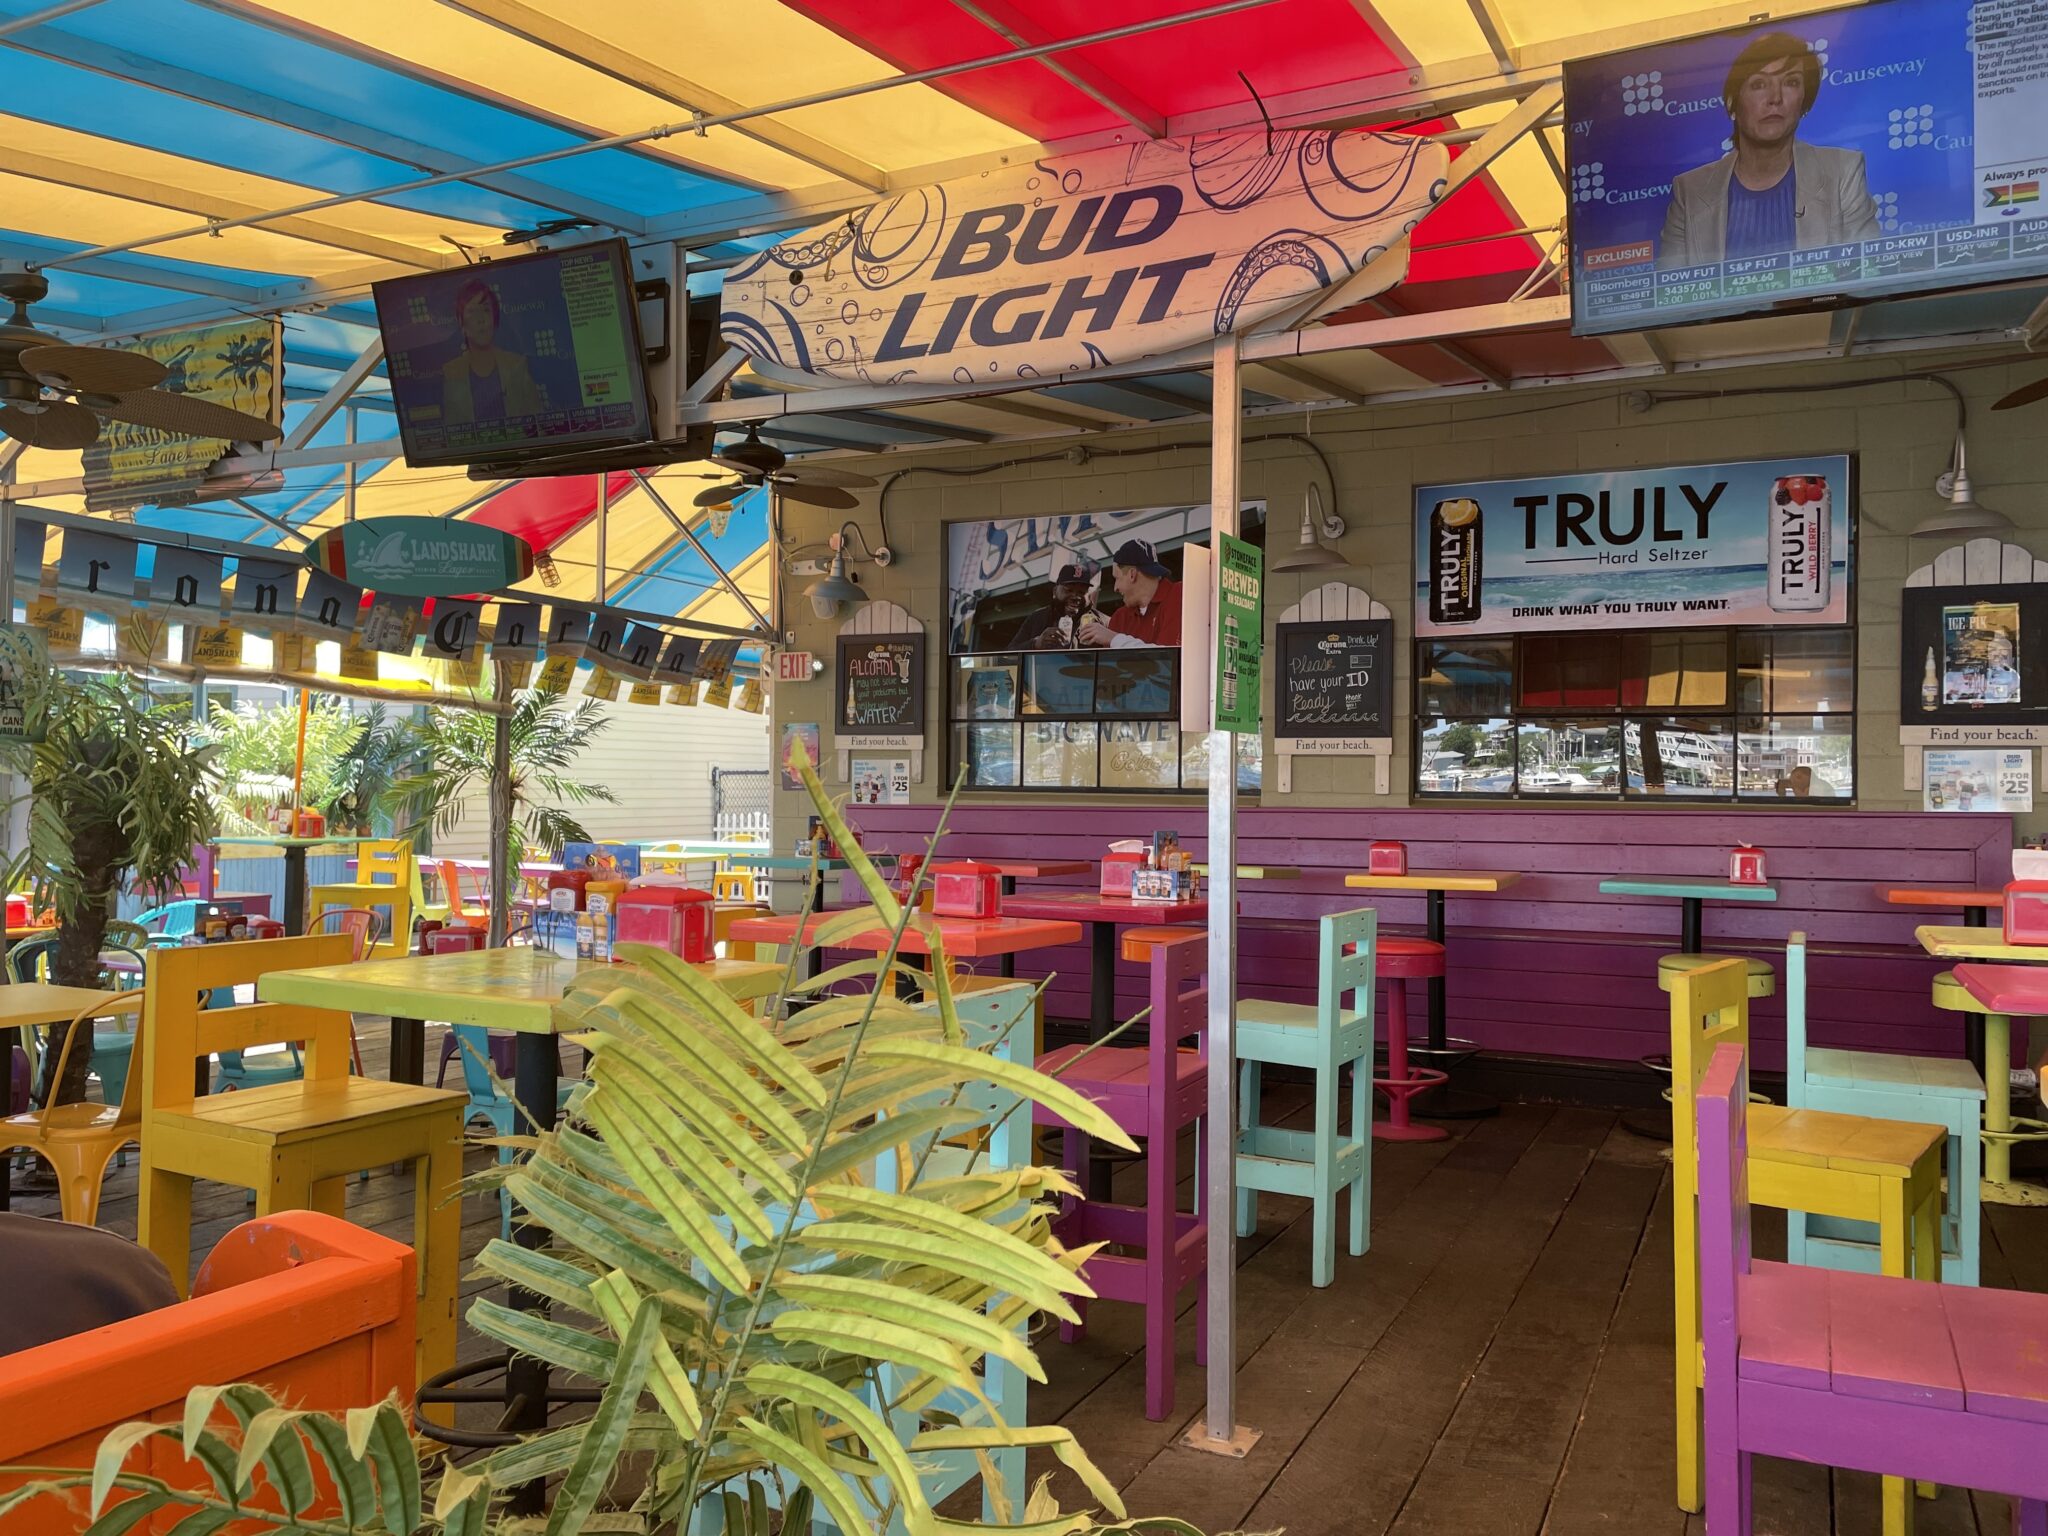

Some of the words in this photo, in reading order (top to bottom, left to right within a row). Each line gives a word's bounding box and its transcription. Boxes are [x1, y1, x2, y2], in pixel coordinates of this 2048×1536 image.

[1975, 13, 2001, 24] Hang
[2003, 10, 2011, 18] in
[2013, 8, 2030, 16] the
[1975, 20, 2015, 33] Shifting
[1978, 42, 1996, 51] The
[1978, 50, 2004, 61] being
[2006, 44, 2039, 55] closely
[1978, 62, 1989, 70] by
[2004, 53, 2043, 65] markets
[1829, 57, 1927, 86] Causeway
[1978, 69, 1997, 80] deal
[1999, 64, 2026, 75] would
[1978, 75, 2024, 89] sanctions
[2026, 73, 2038, 81] on
[1978, 86, 2016, 98] exports.
[1934, 135, 1973, 151] Cau
[1984, 170, 2025, 182] Always
[932, 184, 1184, 280] BUD
[1946, 226, 1999, 243] USD-INR
[1977, 240, 2000, 250] VIEW
[1587, 246, 1651, 265] EXCLUSIVE
[1807, 250, 1831, 261] FUT
[1875, 253, 1900, 263] 2-DAY
[1902, 250, 1924, 259] VIEW
[1729, 260, 1752, 273] S&P
[1755, 257, 1778, 269] FUT
[1661, 270, 1690, 283] DOW
[1693, 266, 1716, 279] FUT
[1731, 272, 1774, 286] 4236.60
[1590, 277, 1650, 293] Bloomberg
[1664, 281, 1712, 296] 34357.00
[874, 252, 1217, 363] LIGHT
[1513, 481, 1728, 549] TRULY
[1809, 521, 1817, 552] BERRY
[411, 539, 497, 562] LANDSHARK
[1231, 548, 1257, 568] STONEFACE
[1599, 549, 1638, 565] Hard
[1648, 547, 1709, 562] Seltzer
[1782, 508, 1804, 594] TRULY
[1440, 529, 1461, 610] TRULY
[1809, 554, 1817, 581] WILD
[1222, 566, 1259, 599] BREWED
[1460, 557, 1469, 598] ORIGINAL
[1234, 594, 1255, 611] SEACOAST
[1512, 606, 1554, 617] DRINK
[1559, 604, 1599, 615] WHAT
[1604, 603, 1631, 614] YOU
[1636, 601, 1678, 612] TRULY
[1683, 599, 1731, 611] WANT.
[1948, 617, 1965, 631] ICE
[1318, 641, 1347, 650] Corona
[1347, 635, 1363, 644] Drink
[1367, 633, 1379, 645] Up!
[780, 653, 808, 680] EXIT
[850, 658, 897, 677] ALCOHOL
[1289, 655, 1336, 674] Please
[1290, 677, 1316, 692] have
[1320, 675, 1344, 693] your
[1346, 670, 1369, 687] ID
[1294, 692, 1336, 713] Ready
[2, 716, 25, 726] CANS
[856, 706, 898, 725] WATER
[1094, 721, 1172, 743] WAVE
[1930, 728, 1960, 740] Find
[1963, 730, 1992, 747] your
[851, 737, 866, 746] Find
[869, 738, 885, 749] your
[1296, 739, 1317, 750] Find
[1320, 741, 1340, 752] your
[2000, 780, 2029, 794] $25
